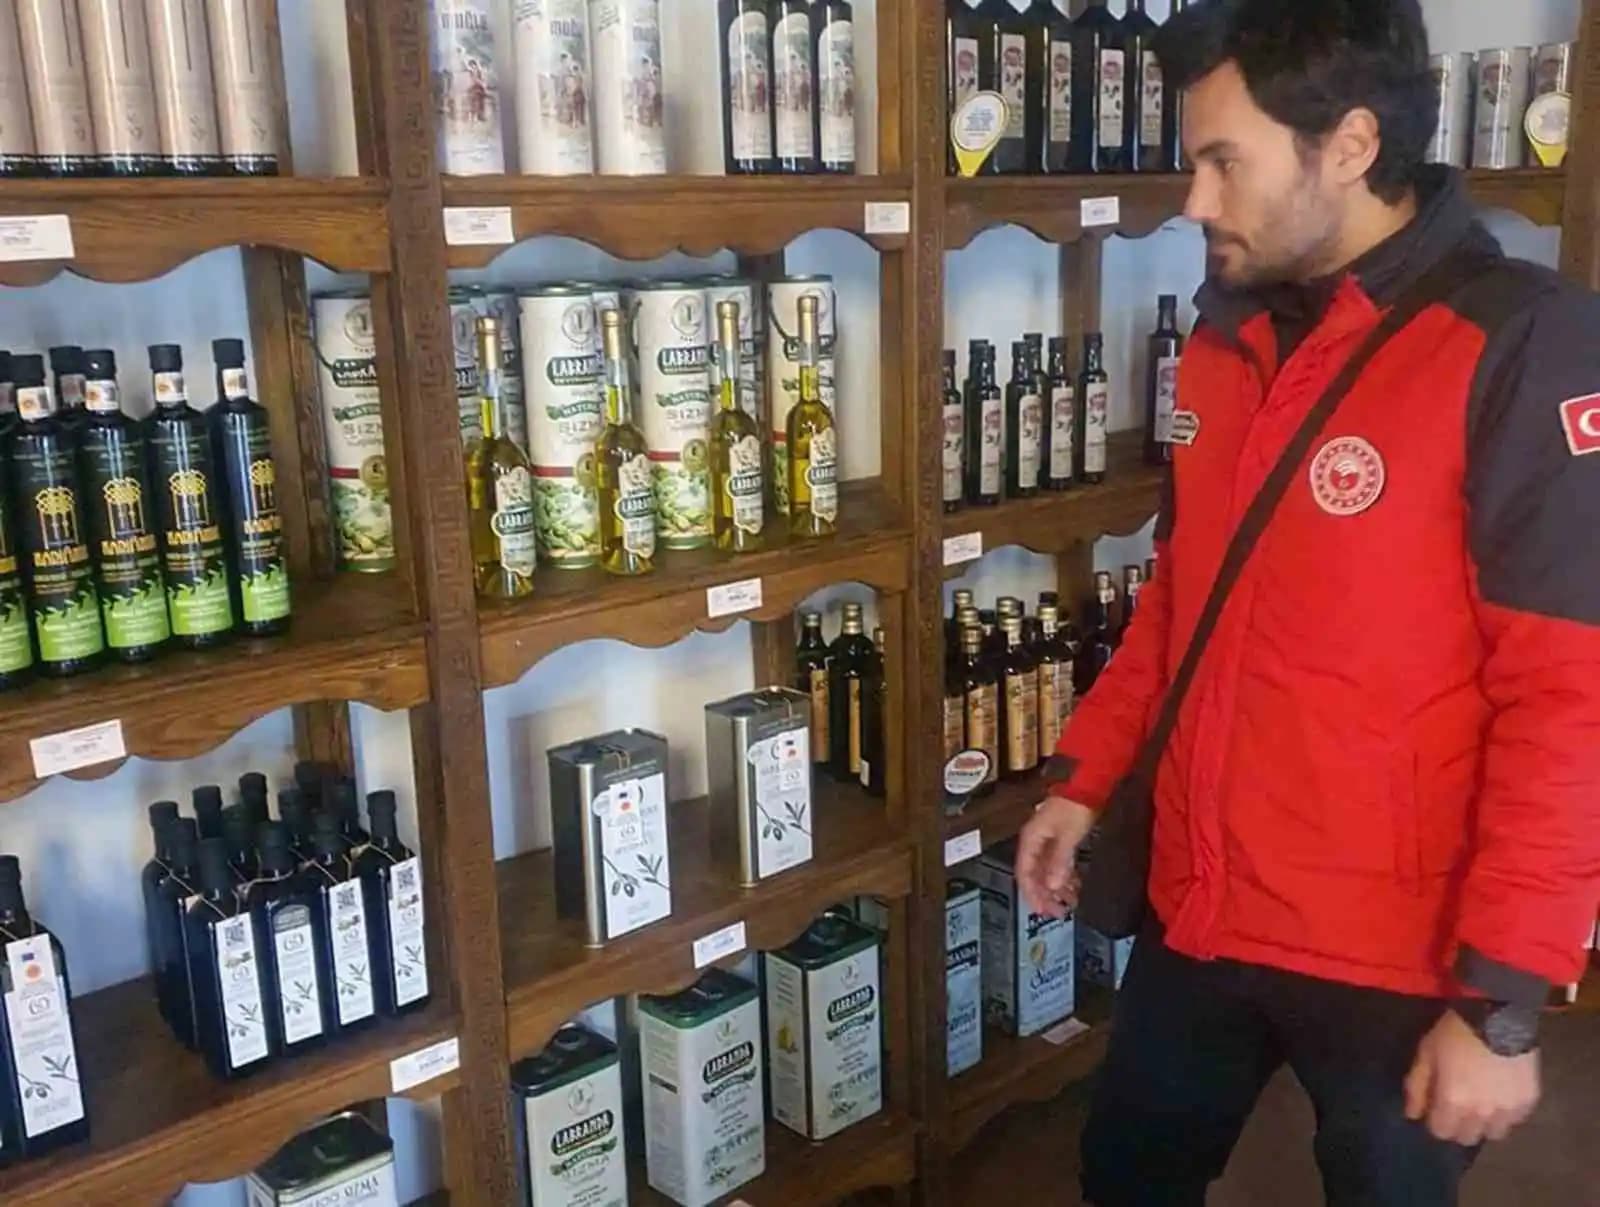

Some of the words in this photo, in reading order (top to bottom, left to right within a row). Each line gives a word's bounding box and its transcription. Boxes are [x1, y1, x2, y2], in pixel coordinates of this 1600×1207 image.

[662, 349, 705, 366] LABRA
[553, 359, 598, 376] LABRA
[555, 1112, 610, 1149] LABRANDA
